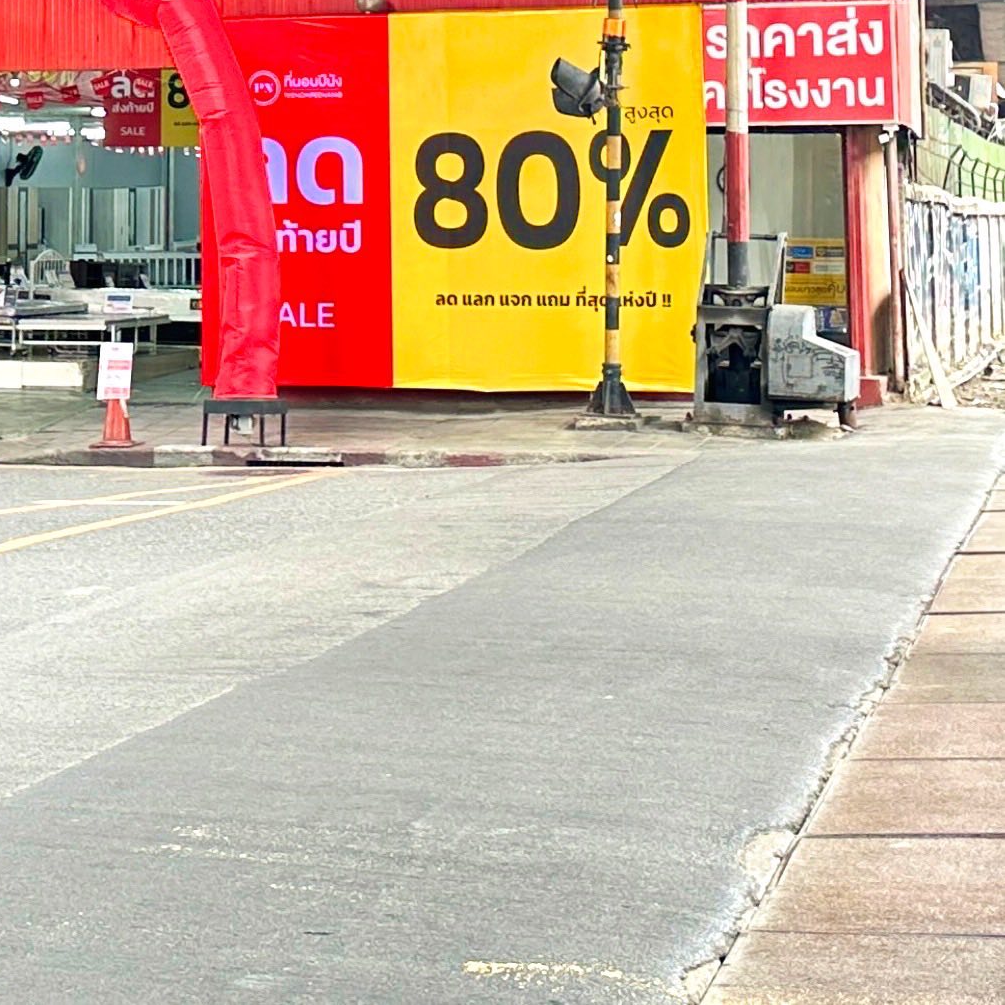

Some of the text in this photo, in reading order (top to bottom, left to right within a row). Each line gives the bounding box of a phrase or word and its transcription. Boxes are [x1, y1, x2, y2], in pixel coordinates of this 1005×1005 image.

[705, 6, 885, 60] ราคาส่ง
[283, 70, 344, 88] ที่นอนปีนัง
[703, 66, 886, 110] คโรงงาน
[624, 104, 674, 125] สูงสุด
[120, 126, 146, 136] SALE
[413, 129, 691, 251] 80%
[275, 219, 363, 254] ท้ายปี
[435, 286, 672, 313] ลด แลก แจก แถม ที่สุดห่งปี !!
[278, 301, 336, 328] ALE
